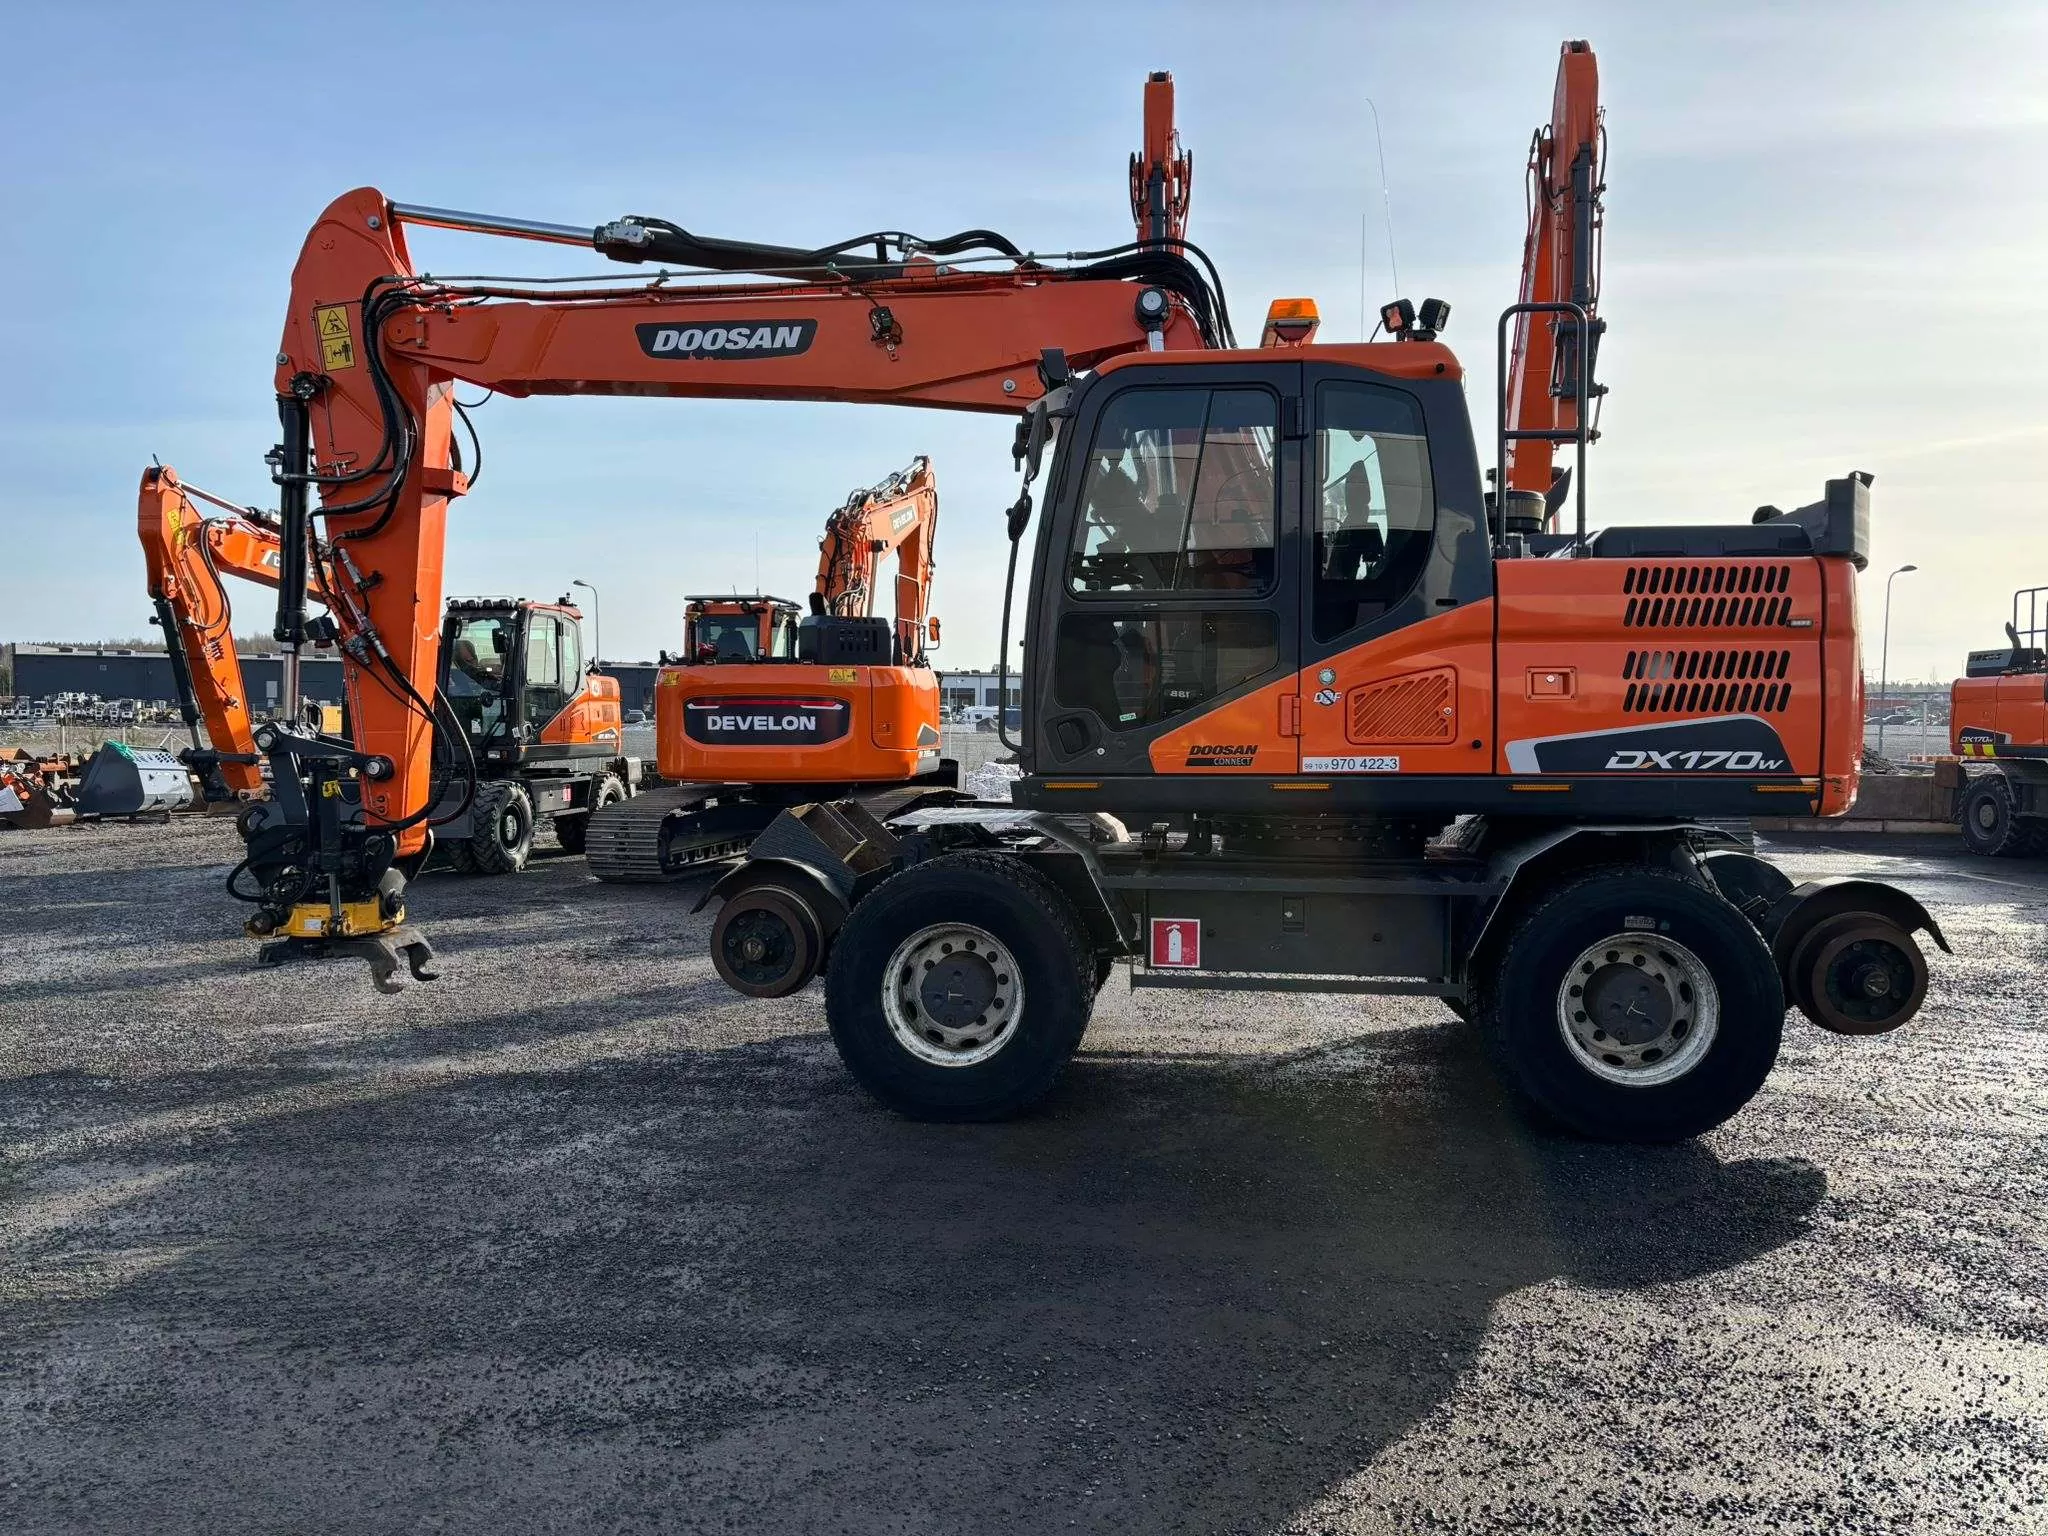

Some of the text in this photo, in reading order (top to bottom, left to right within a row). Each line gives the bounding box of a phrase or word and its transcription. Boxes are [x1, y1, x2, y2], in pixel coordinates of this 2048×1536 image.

[652, 326, 803, 352] DOOSAN
[707, 715, 816, 731] DEVELON
[1188, 745, 1259, 756] DOOSAN
[1213, 758, 1252, 766] CONNECT
[1331, 758, 1356, 770] 970
[1360, 758, 1398, 770] 422-3
